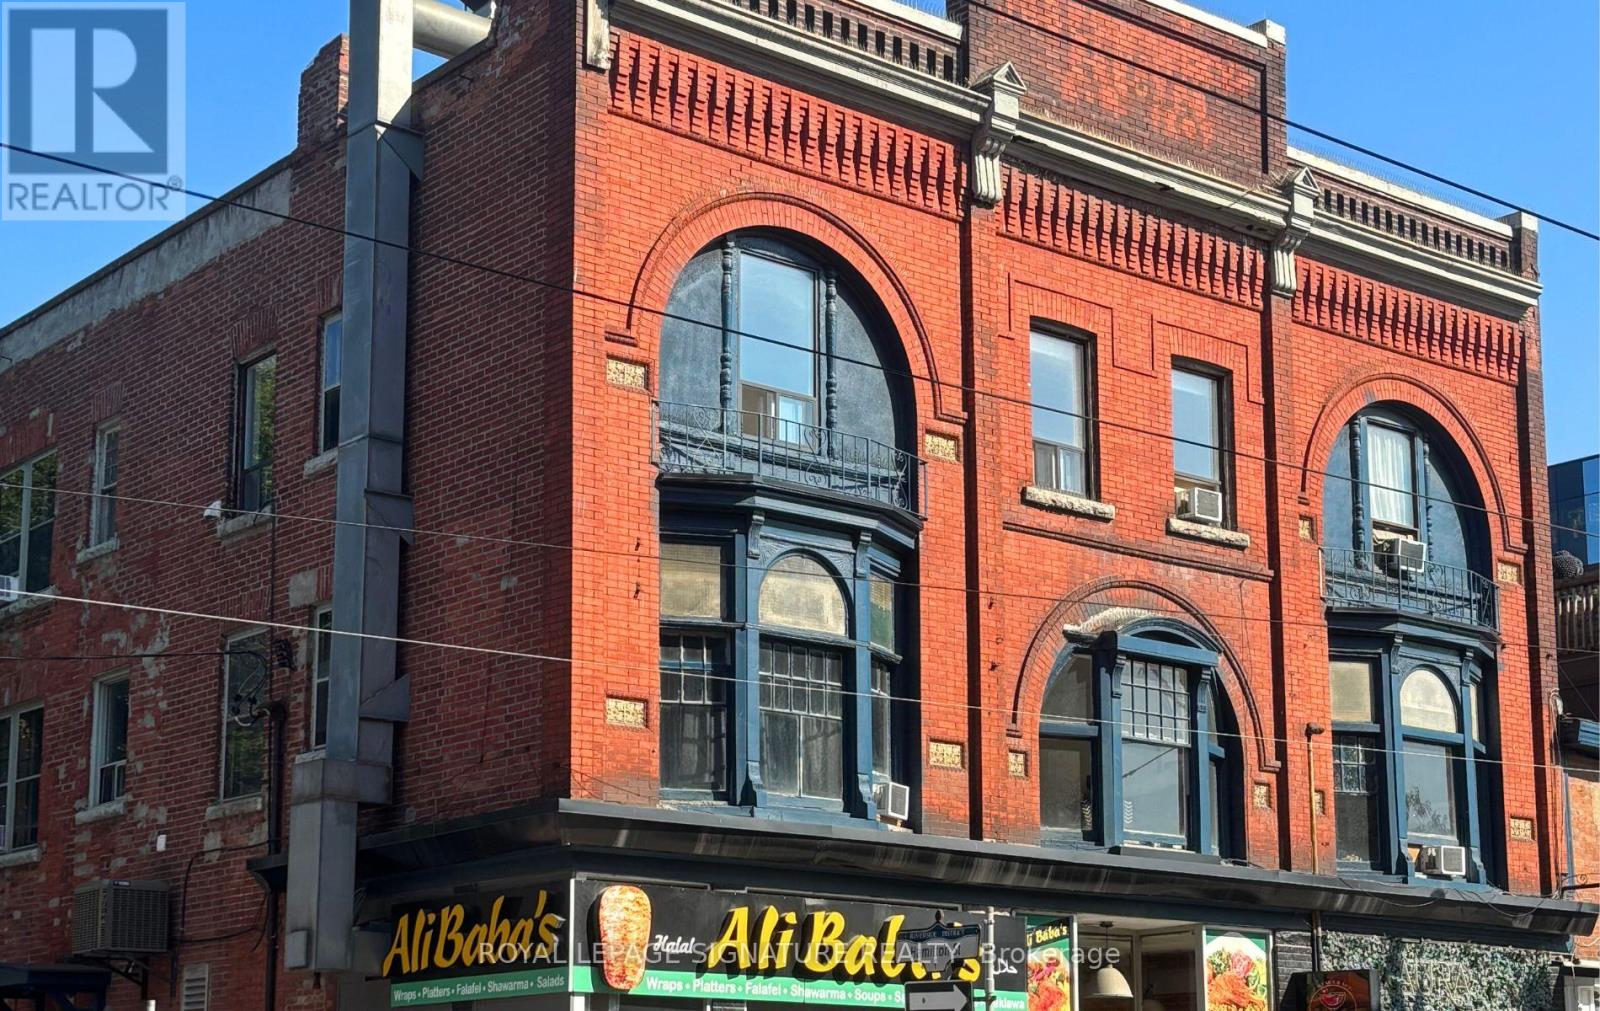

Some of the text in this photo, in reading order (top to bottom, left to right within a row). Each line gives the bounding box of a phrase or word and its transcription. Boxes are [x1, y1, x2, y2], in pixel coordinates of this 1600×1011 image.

[653, 934, 695, 954] Halal
[707, 905, 796, 970] Ali
[393, 974, 565, 1002] Wraps Platters Falafel Shawarma Salads
[646, 977, 683, 993] Wraps
[692, 980, 736, 994] Platters
[745, 981, 781, 996] Falafel
[790, 984, 846, 1000] Shawarma
[854, 988, 886, 1003] Soups
